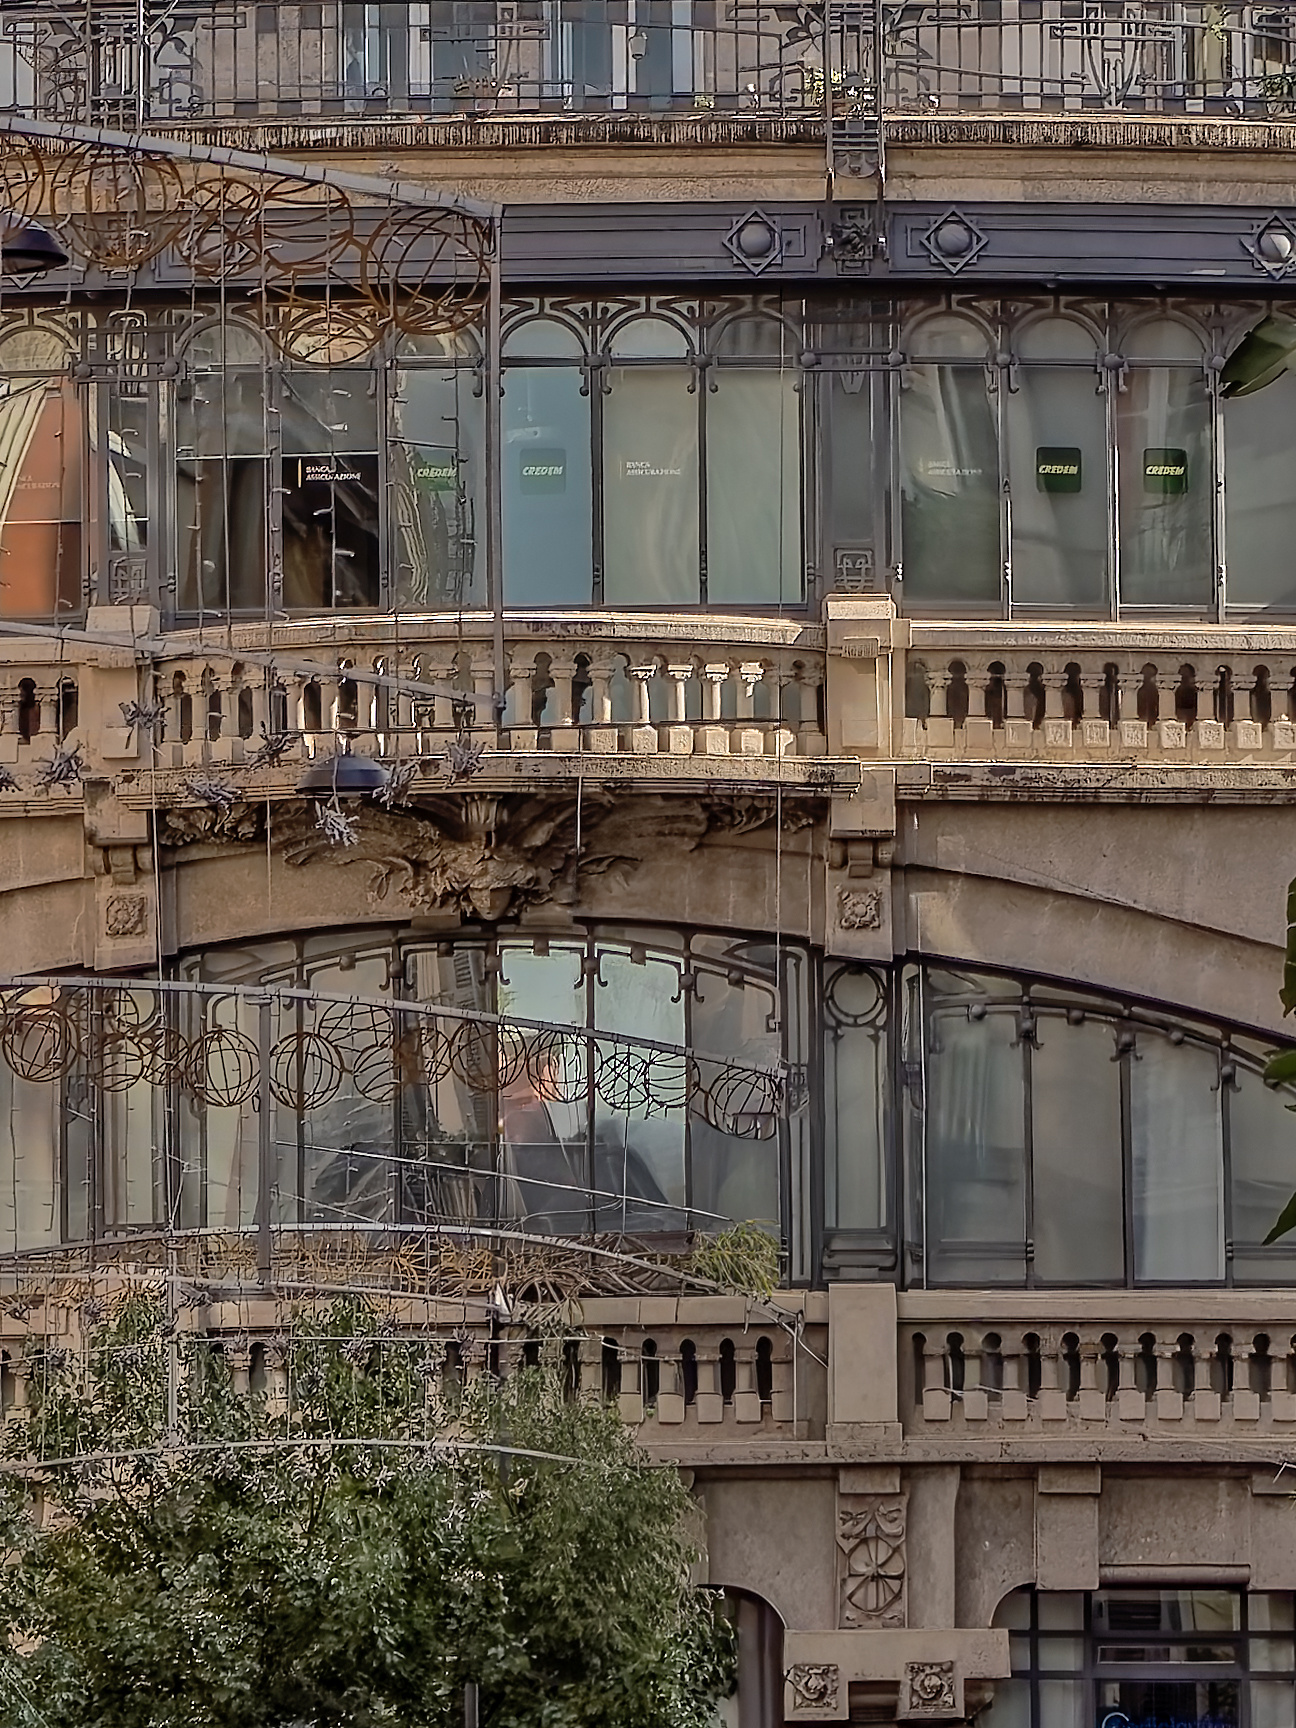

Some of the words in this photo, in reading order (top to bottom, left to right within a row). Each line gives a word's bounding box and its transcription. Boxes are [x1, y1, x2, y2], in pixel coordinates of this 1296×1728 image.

[417, 466, 457, 478] CREDEM
[522, 465, 564, 476] CREDEM
[1038, 464, 1078, 475] CREDEM
[1145, 465, 1185, 476] CREDEM
